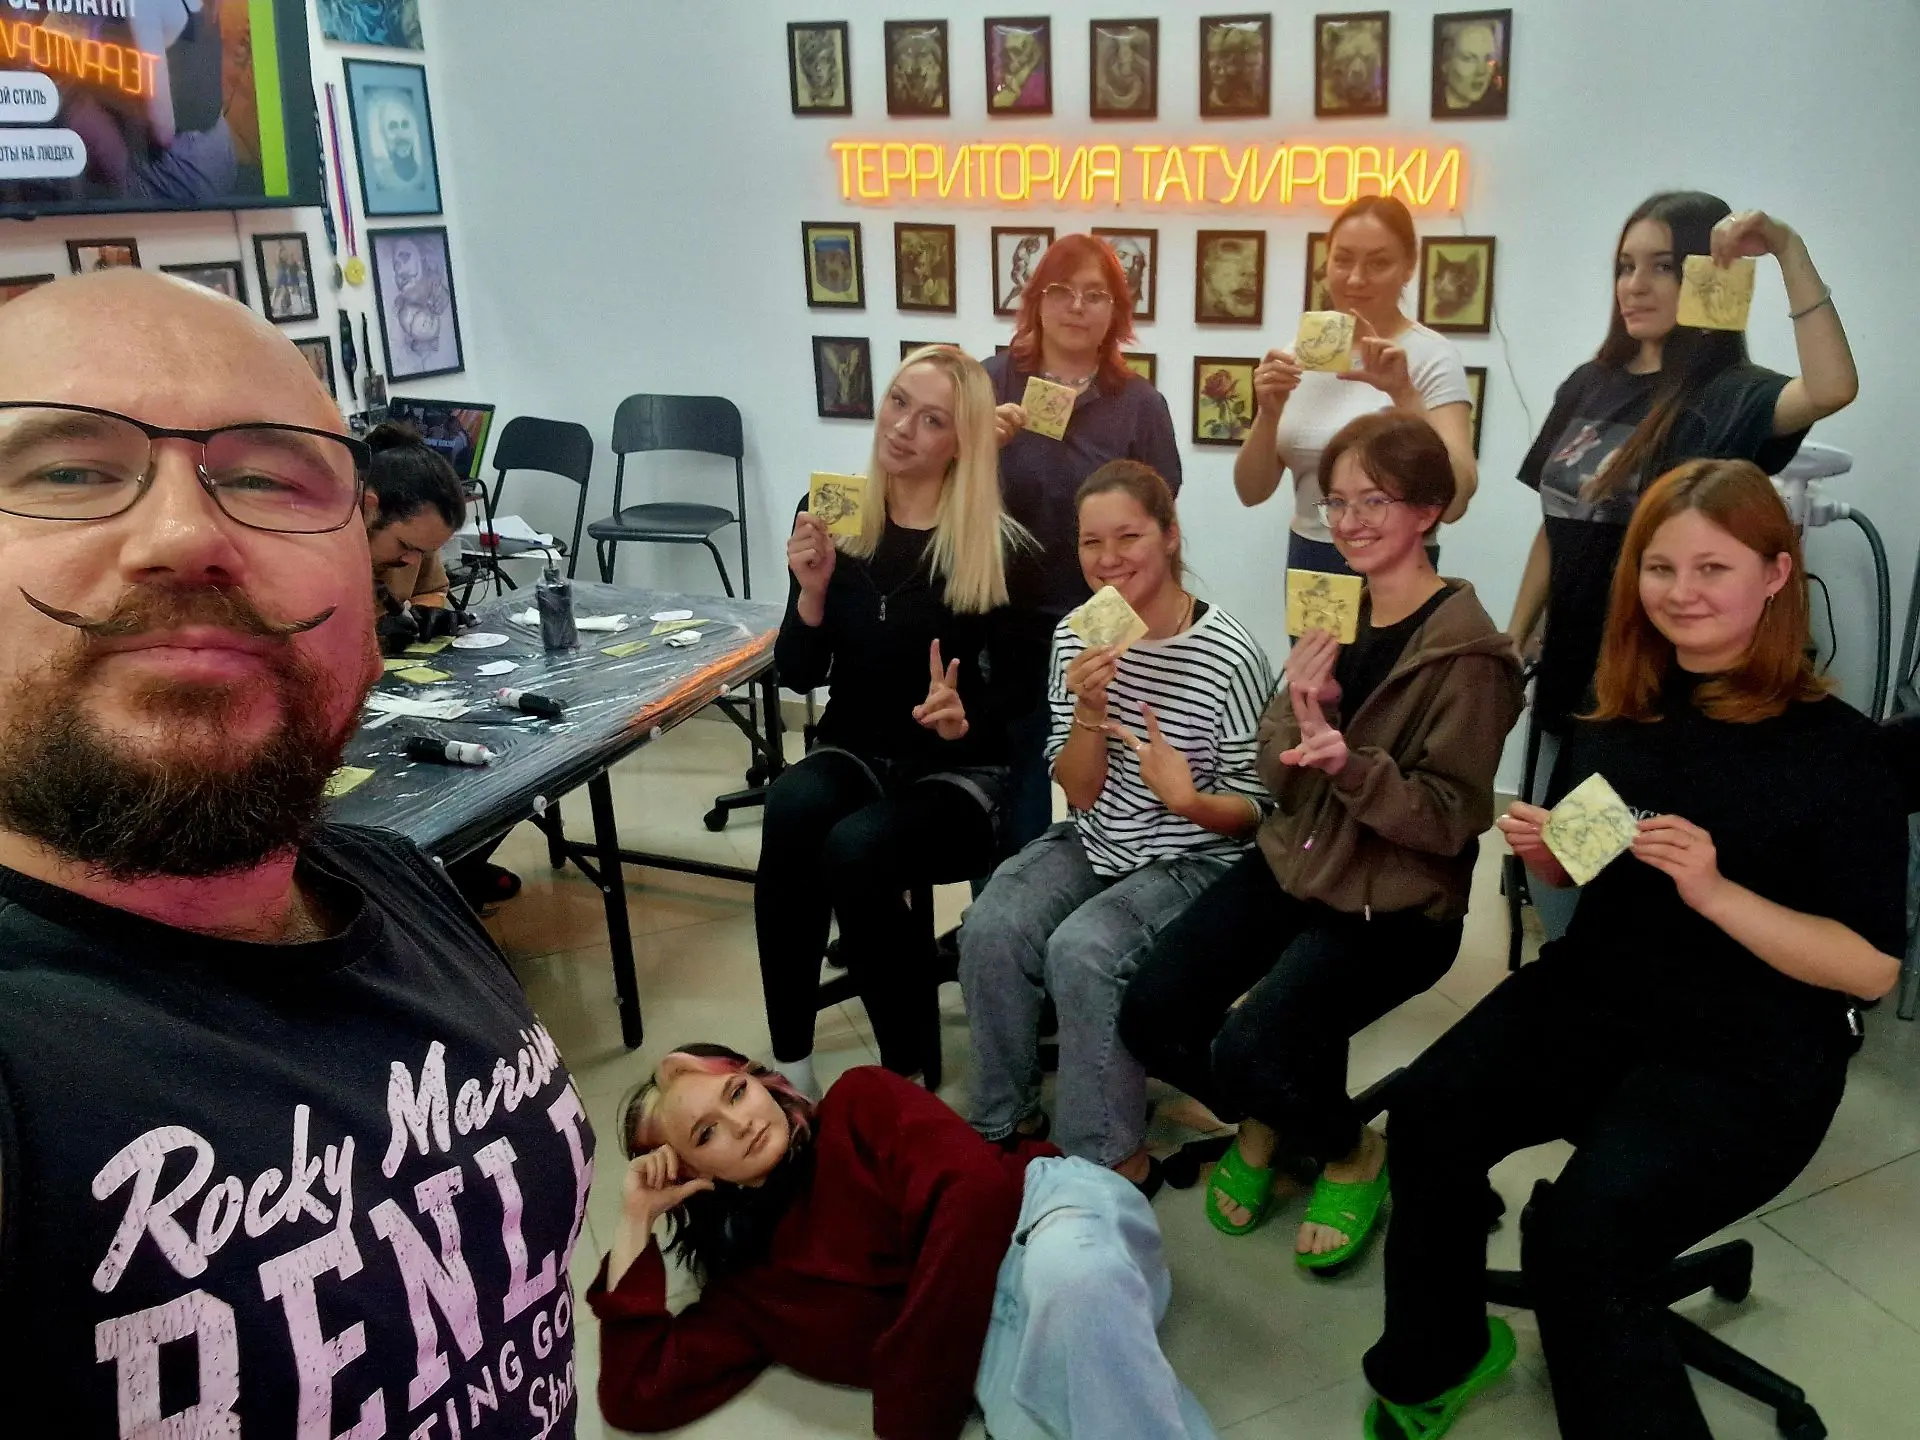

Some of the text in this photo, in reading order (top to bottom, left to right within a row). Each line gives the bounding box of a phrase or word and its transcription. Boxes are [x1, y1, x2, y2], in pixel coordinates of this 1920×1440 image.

[13, 87, 47, 105] СТИЛЬ
[21, 145, 35, 161] НА
[37, 145, 75, 162] ЛЮДЯХ
[831, 142, 1461, 206] ТЕРРИТОРИЯ ТАТУИРОВКИ
[92, 1104, 356, 1293] Rocky
